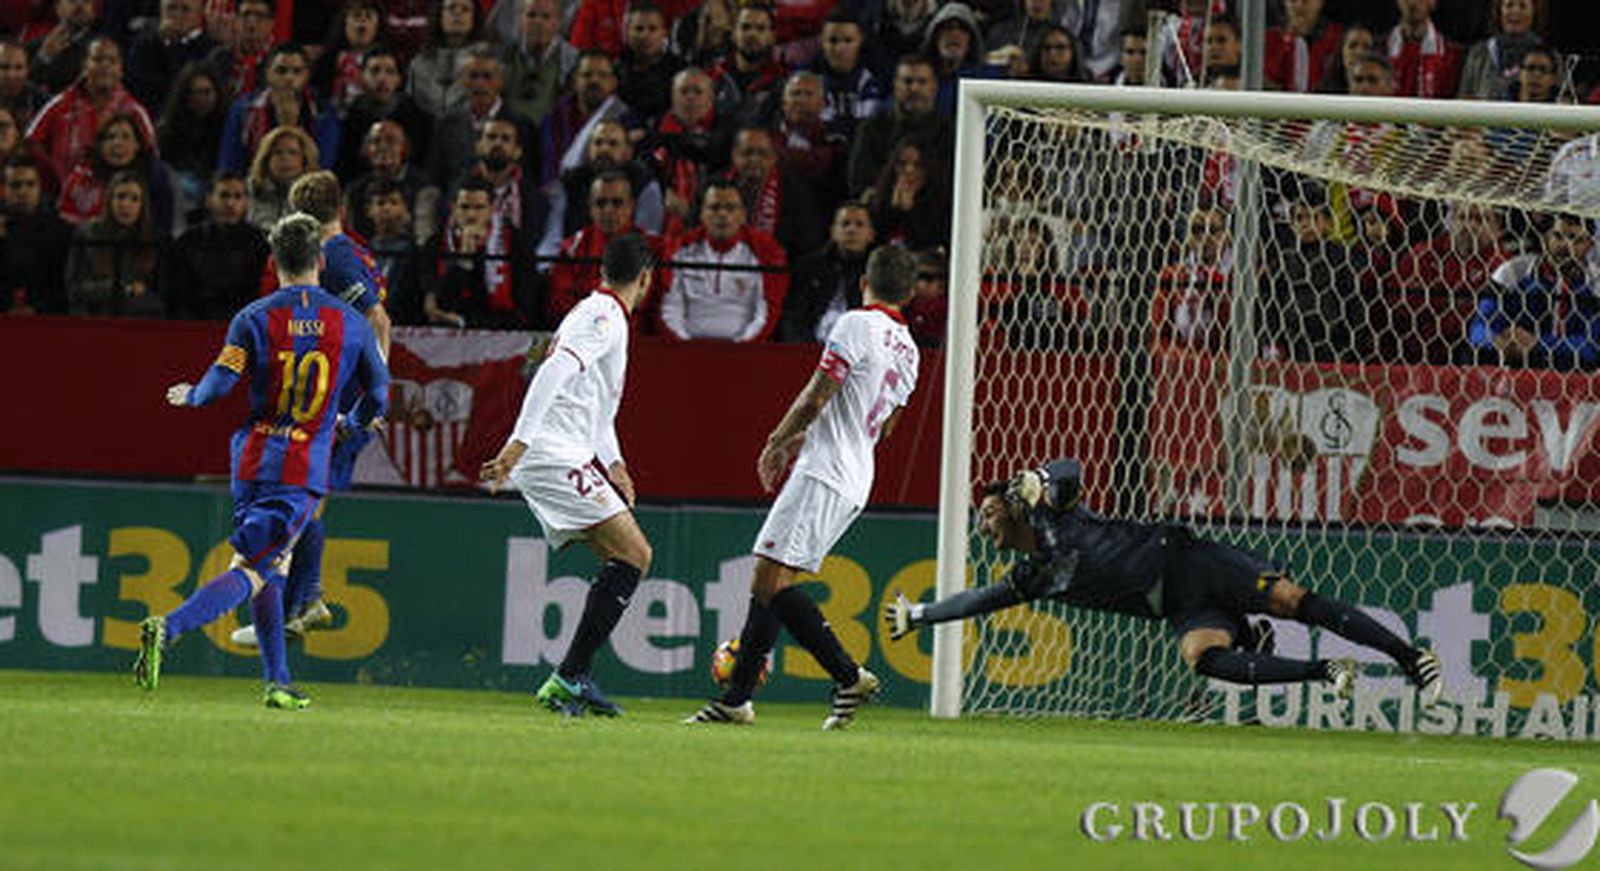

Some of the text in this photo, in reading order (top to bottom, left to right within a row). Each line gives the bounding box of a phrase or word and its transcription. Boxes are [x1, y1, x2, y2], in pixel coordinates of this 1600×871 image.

[288, 319, 325, 337] MESSI
[277, 350, 330, 423] 10
[567, 461, 604, 496] 23
[0, 525, 390, 661] t35
[503, 537, 1071, 687] bet365
[1255, 580, 1600, 709] et3
[1207, 676, 1508, 738] TURKISH
